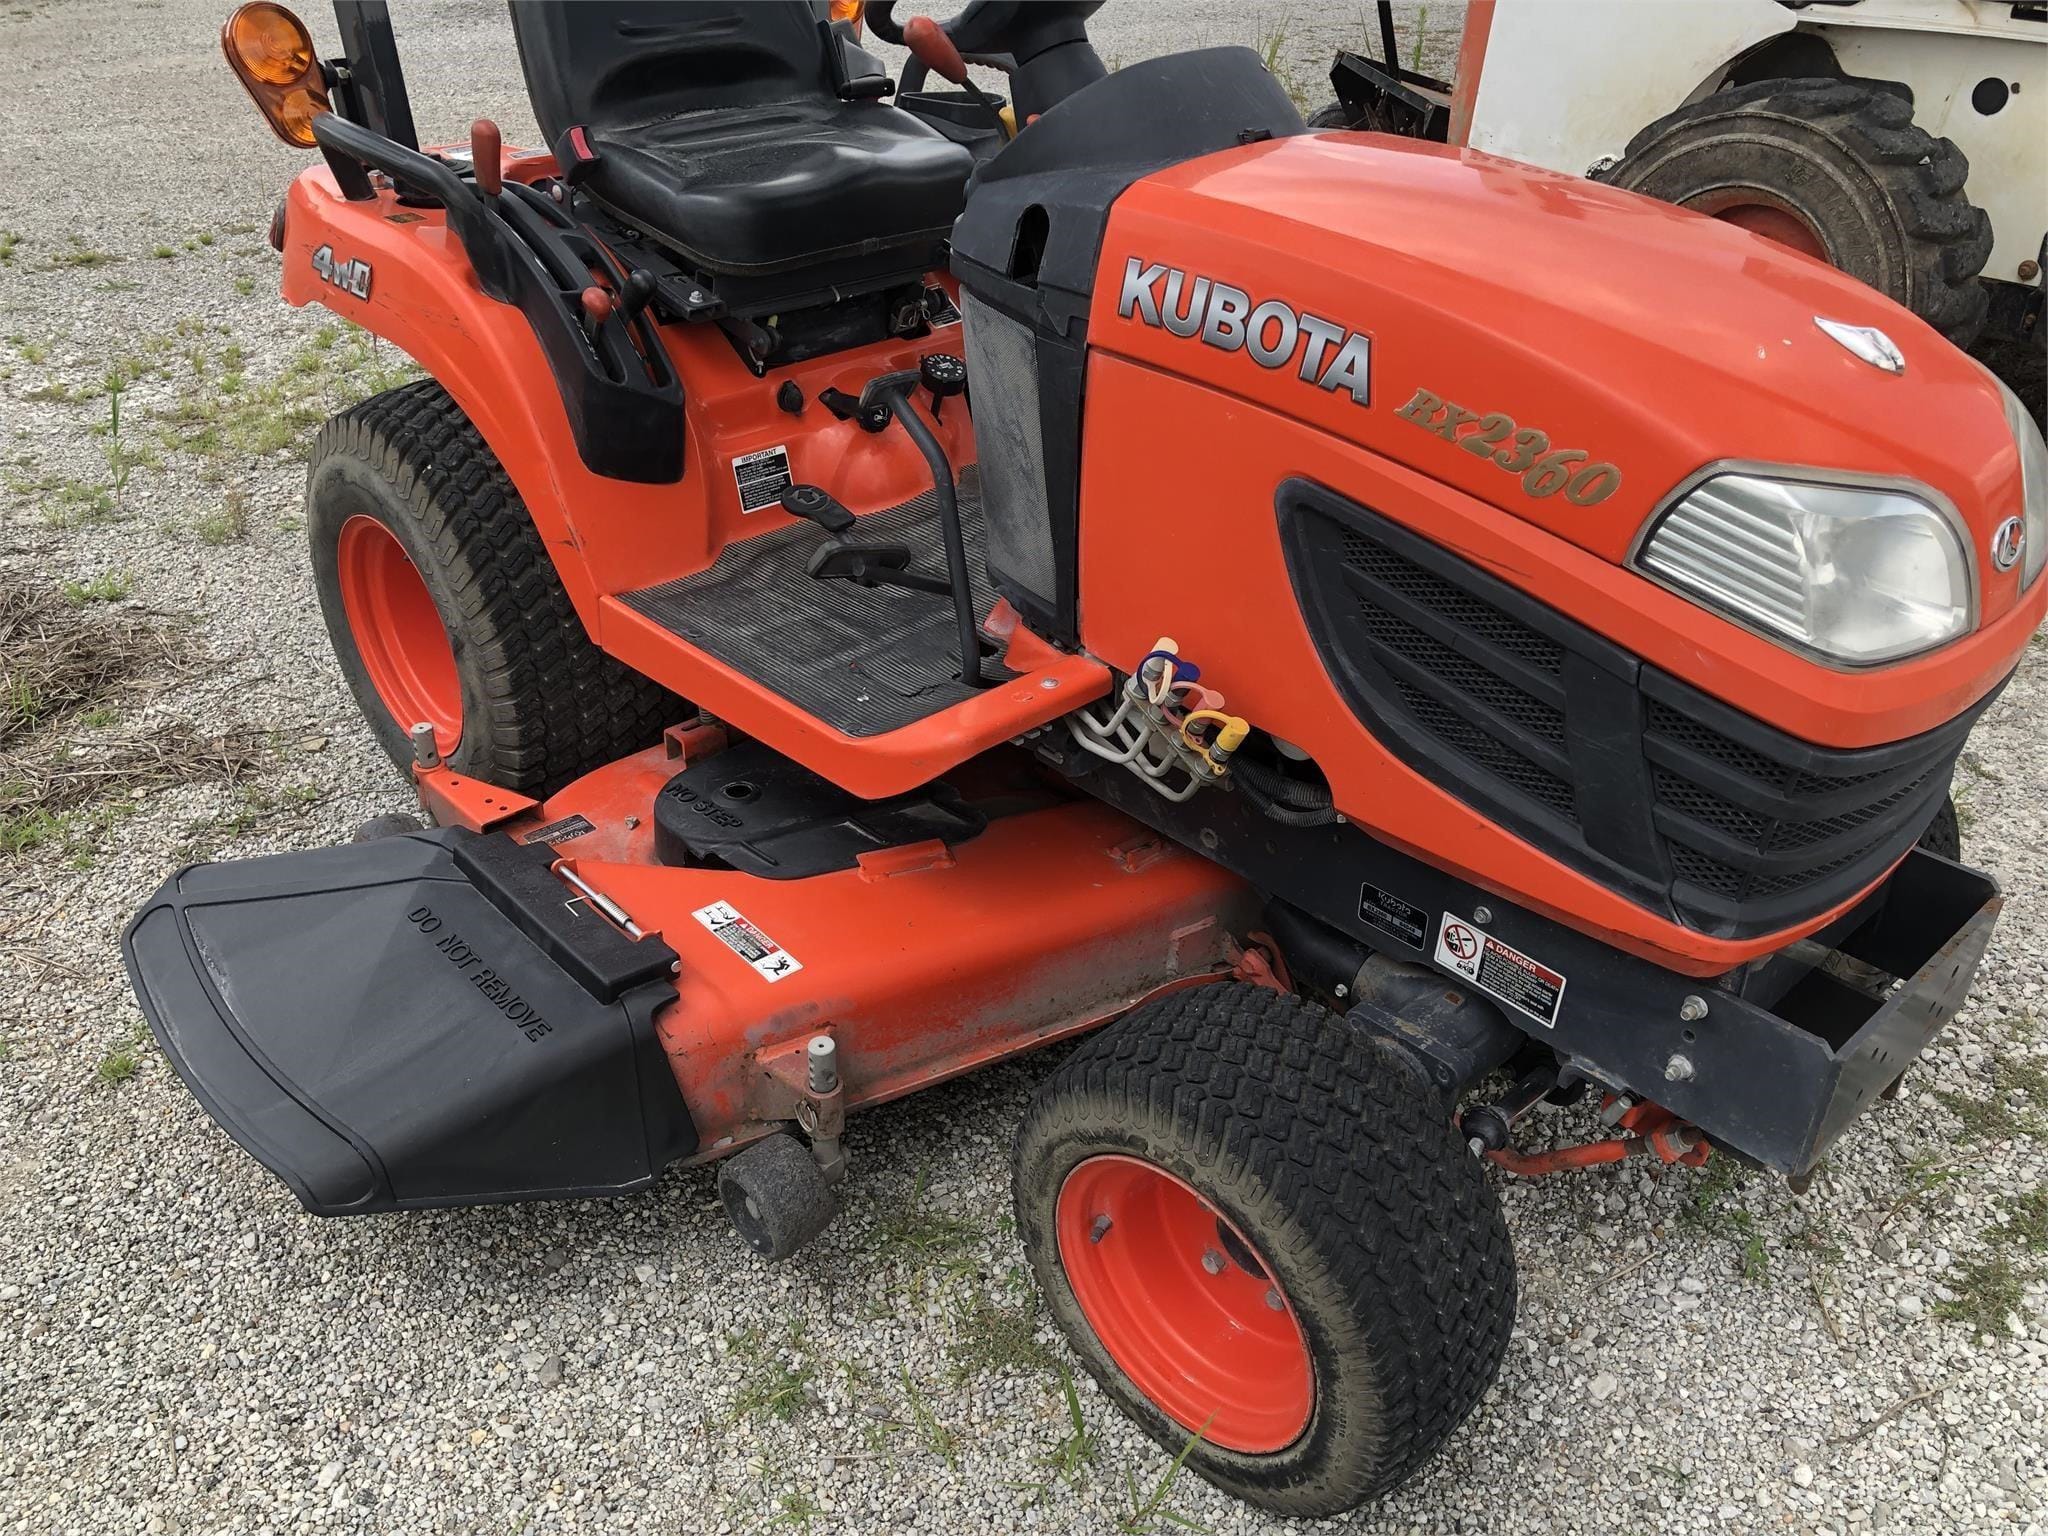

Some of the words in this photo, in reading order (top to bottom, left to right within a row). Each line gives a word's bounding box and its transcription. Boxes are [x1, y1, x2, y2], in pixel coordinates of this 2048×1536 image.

[1846, 163, 1891, 227] SEVERE
[312, 244, 372, 302] 4WD
[1118, 256, 1371, 408] KUBOTA
[741, 449, 777, 463] IMPORTANT
[1393, 387, 1622, 506] BX2360
[665, 783, 698, 803] NO
[692, 800, 743, 828] STEP
[746, 926, 774, 948] DANGER
[1496, 945, 1537, 973] DANGER
[407, 905, 442, 933] DO
[436, 934, 482, 969] NOT
[469, 968, 553, 1043] REMOVE
